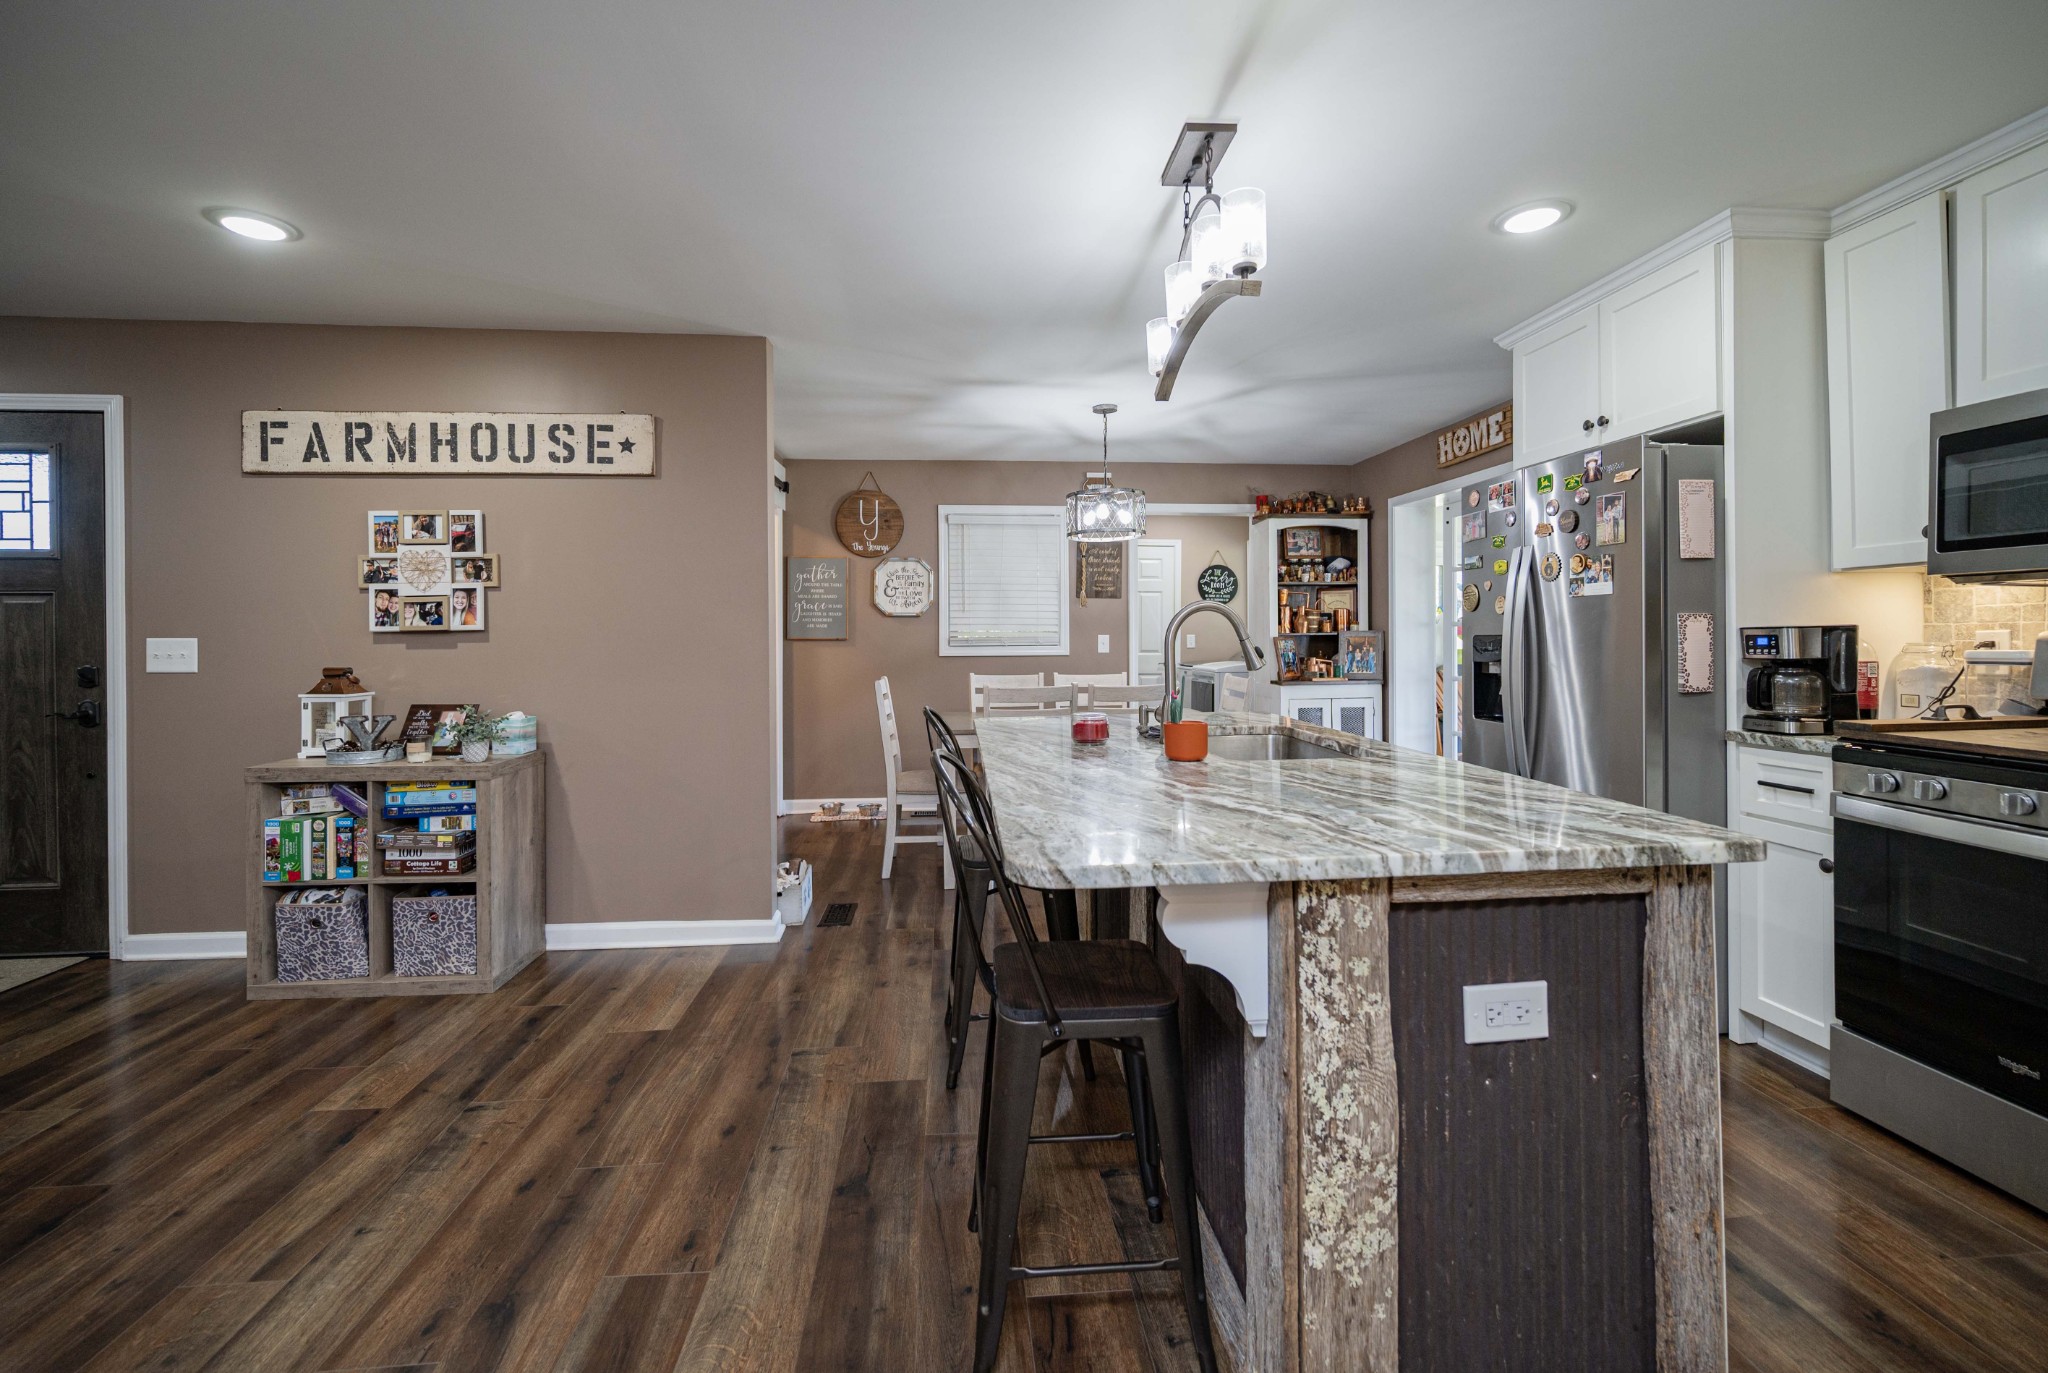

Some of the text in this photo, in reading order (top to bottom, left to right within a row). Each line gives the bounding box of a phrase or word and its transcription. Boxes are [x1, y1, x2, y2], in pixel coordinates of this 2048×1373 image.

[259, 420, 615, 465] FARMHOUSE
[1439, 411, 1504, 464] HOME
[794, 562, 838, 593] gather
[884, 578, 900, 598] &
[1200, 569, 1237, 588] Laundry
[792, 600, 828, 623] grace
[398, 848, 423, 858] 1000
